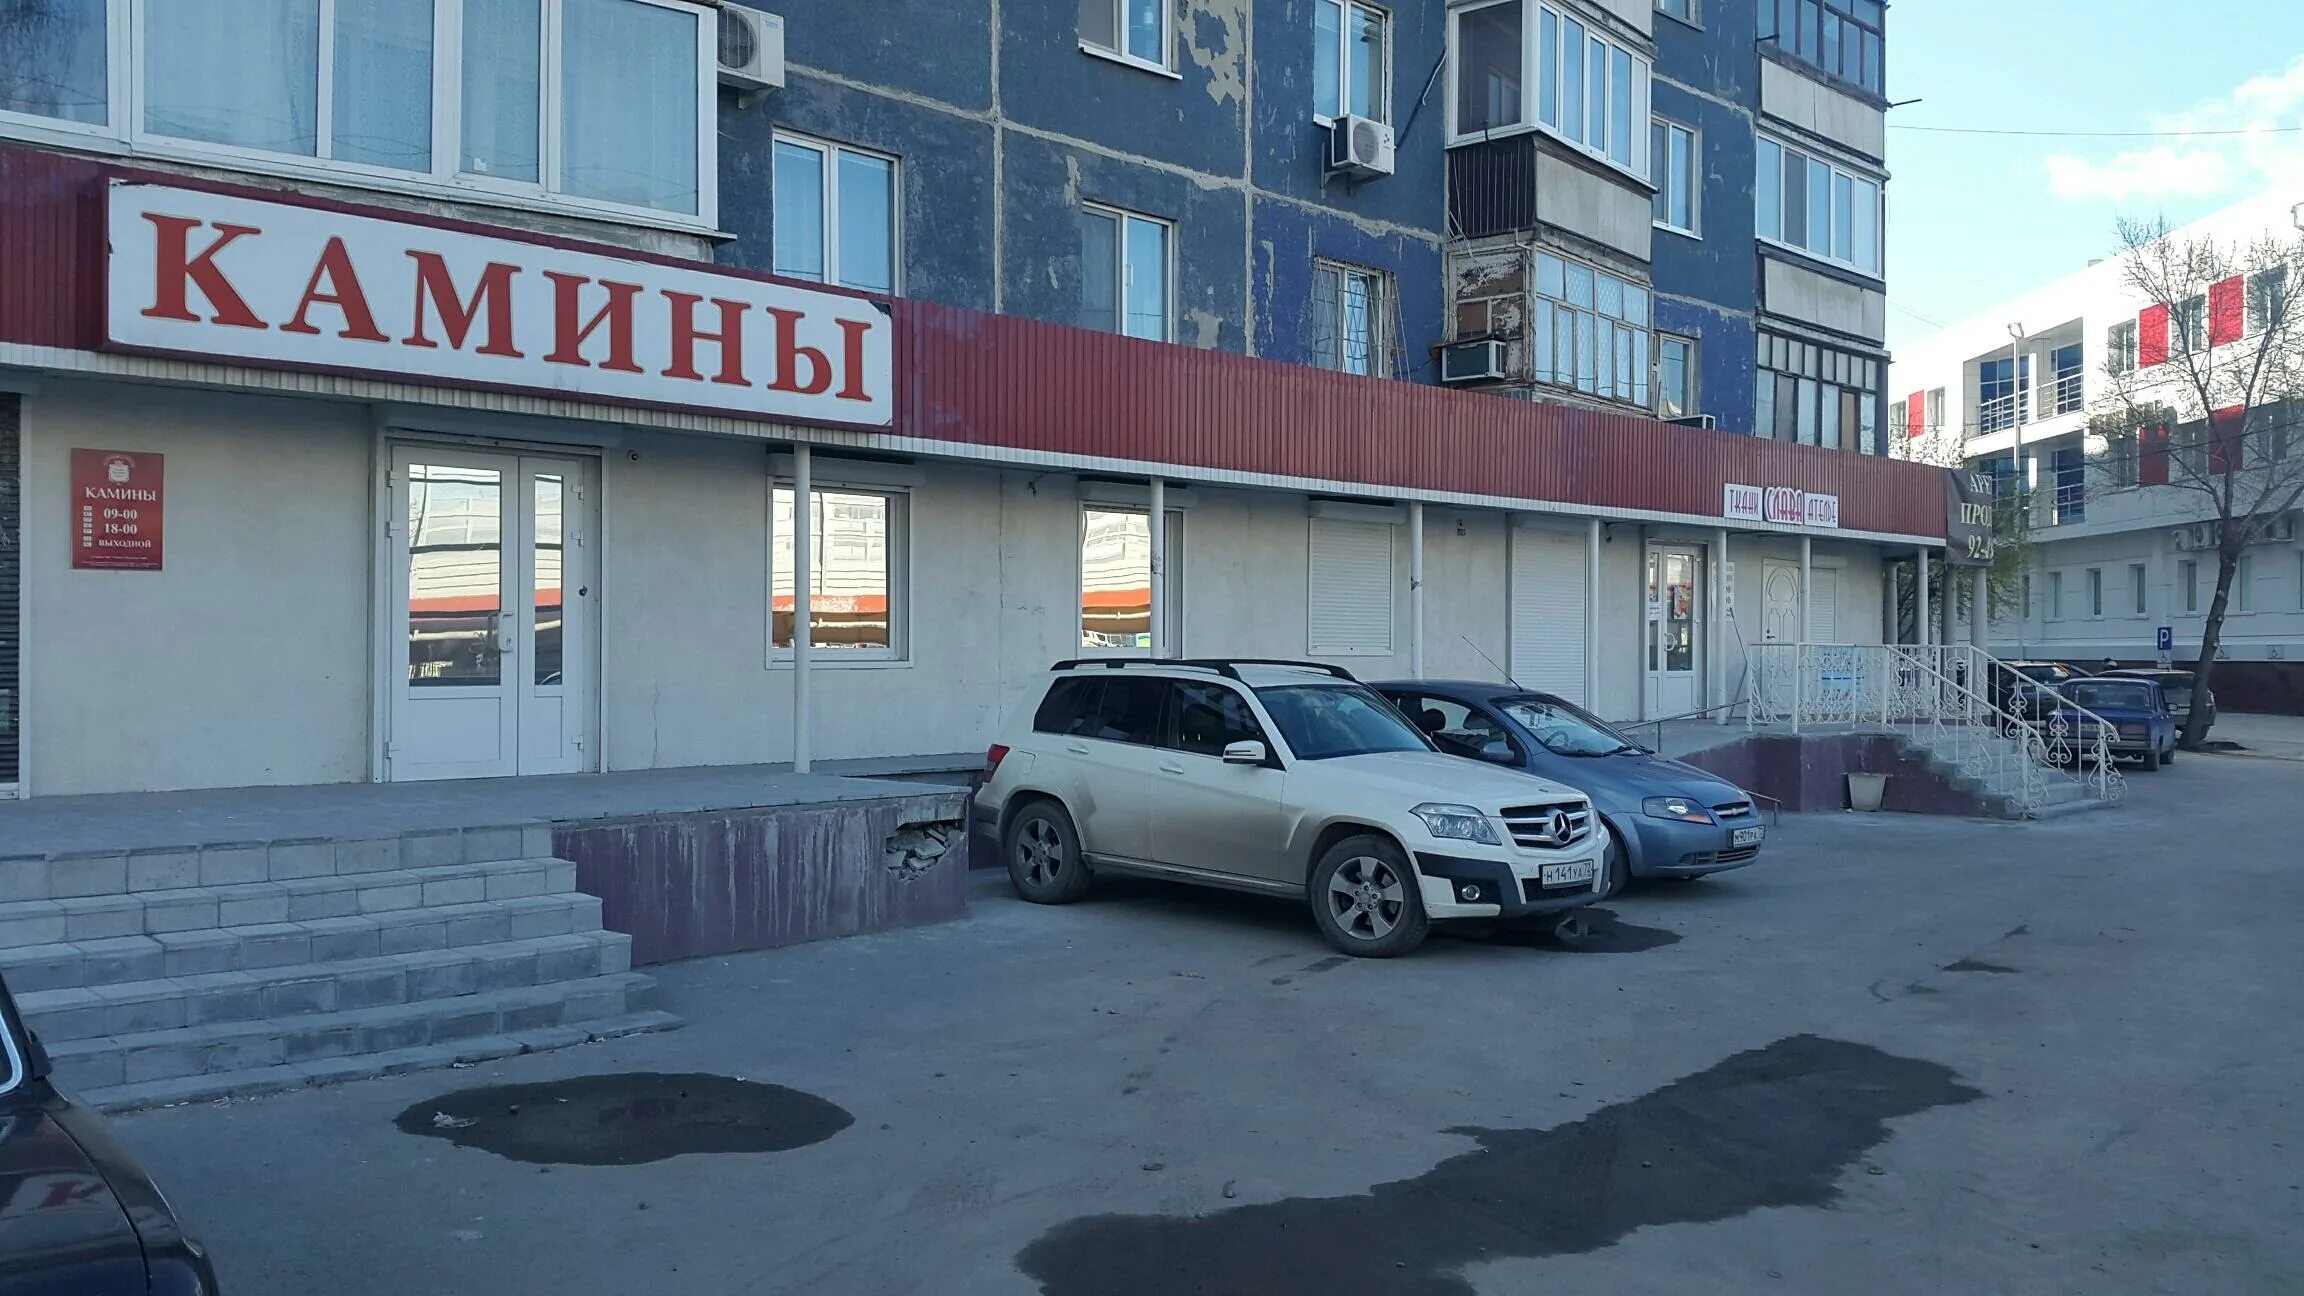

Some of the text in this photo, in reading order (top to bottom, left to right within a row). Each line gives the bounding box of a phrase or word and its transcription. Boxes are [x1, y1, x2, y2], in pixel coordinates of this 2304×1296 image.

[140, 211, 873, 401] КАМИНЫ
[84, 486, 156, 501] КАМИНЫ
[104, 508, 137, 520] 09-00
[1730, 488, 1836, 523] ТКАНИ СЛАВА АТЕЛЬЕ
[104, 523, 137, 534] 18-00
[2160, 629, 2169, 648] P
